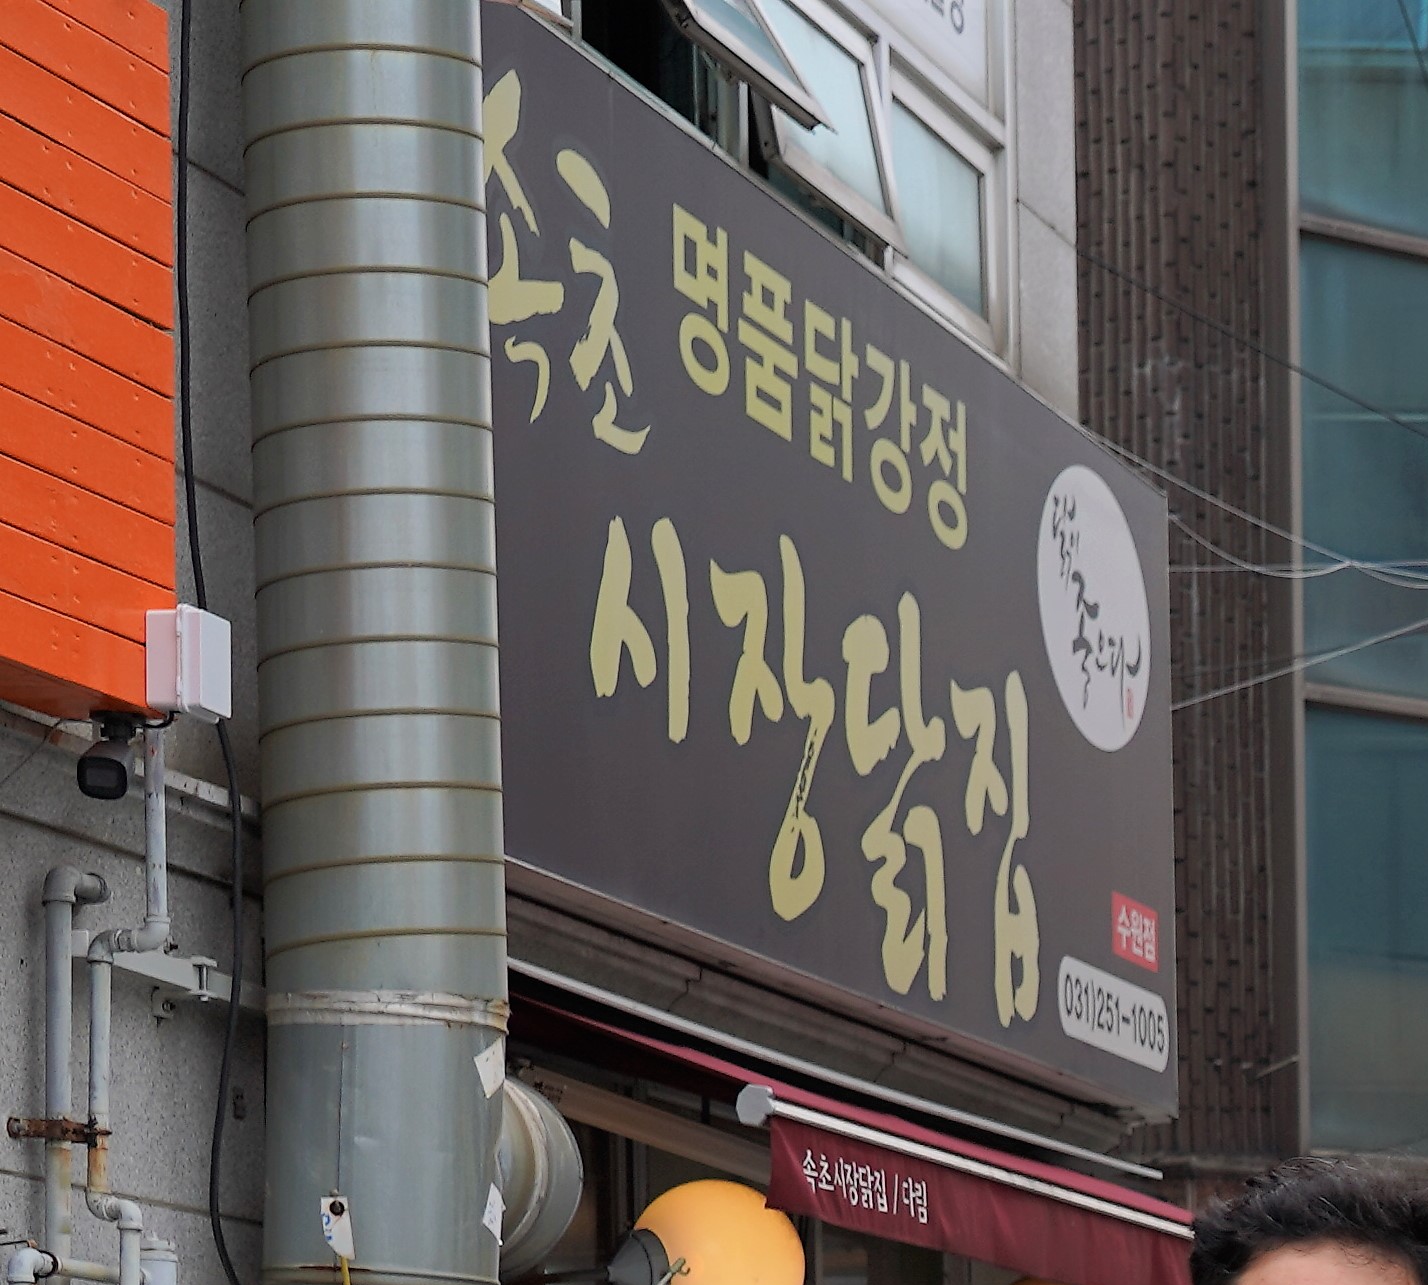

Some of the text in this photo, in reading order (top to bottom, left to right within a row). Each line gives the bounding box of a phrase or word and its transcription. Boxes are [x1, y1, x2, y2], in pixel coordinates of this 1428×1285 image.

[672, 203, 970, 551] 명품닭강정
[591, 516, 1041, 1028] 시장닭집
[1117, 906, 1158, 965] 수원점
[1064, 970, 1166, 1056] 031)251-1005
[803, 1149, 888, 1213] 속초시장닭집
